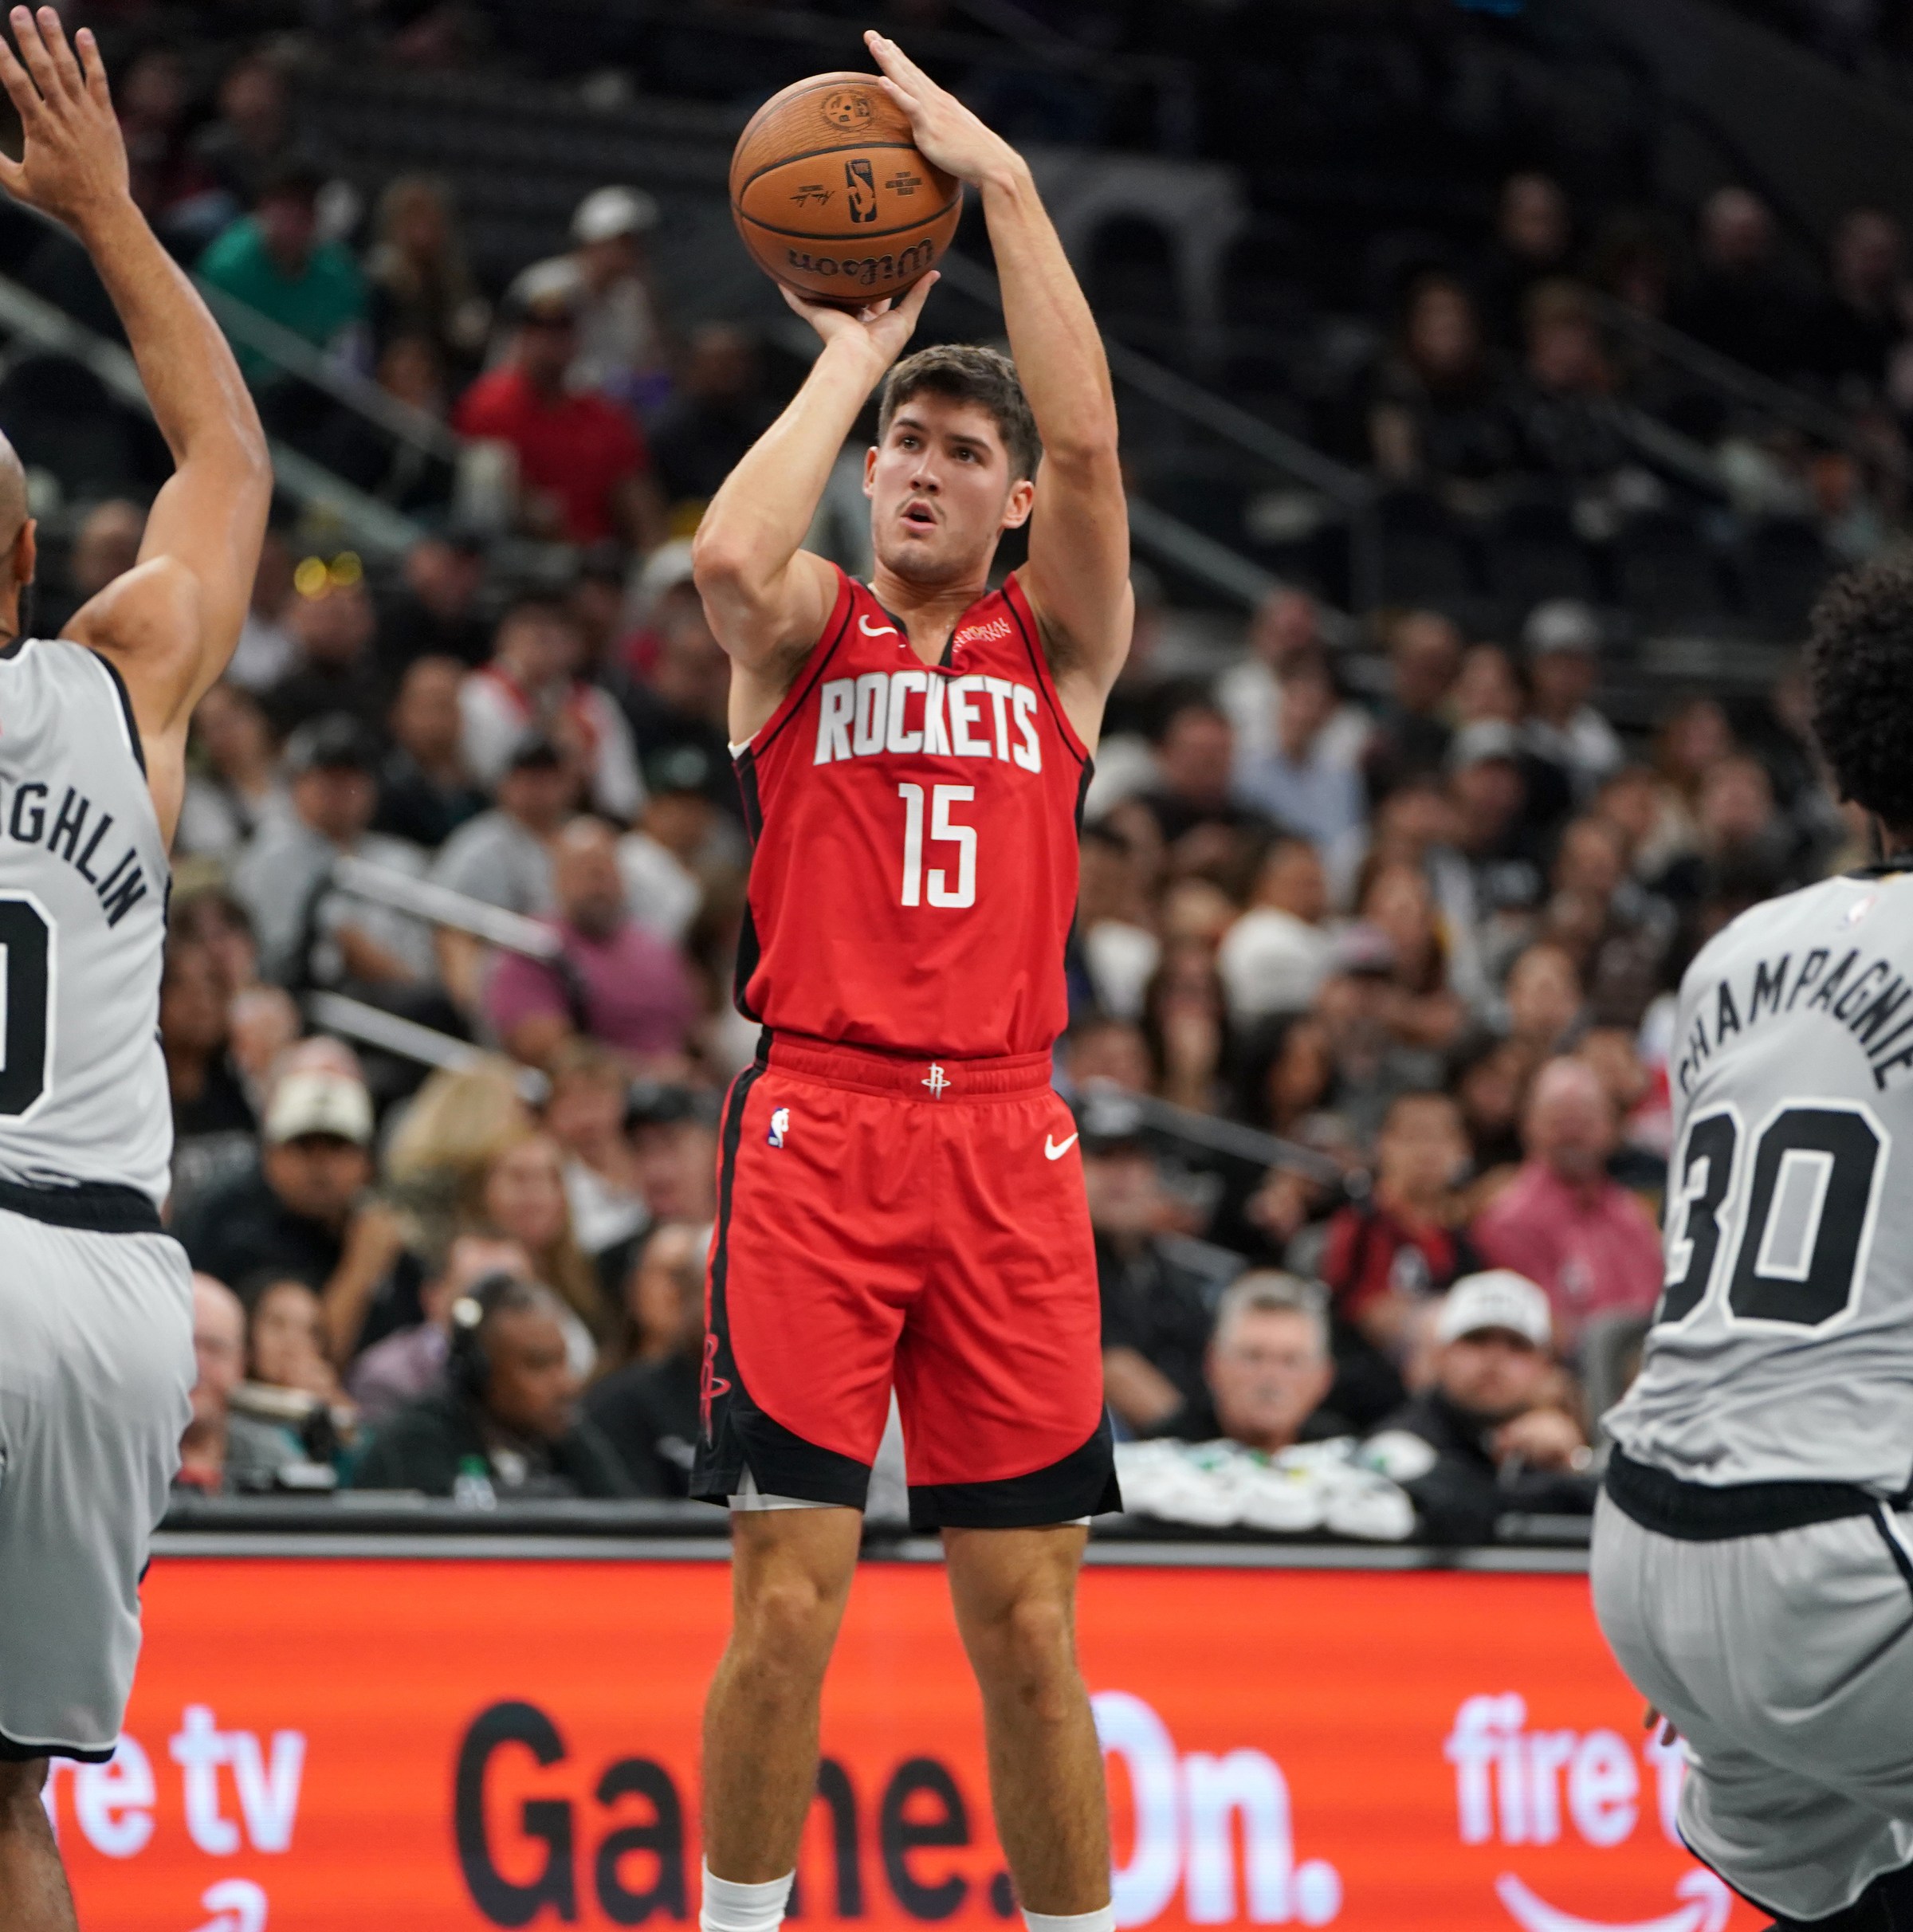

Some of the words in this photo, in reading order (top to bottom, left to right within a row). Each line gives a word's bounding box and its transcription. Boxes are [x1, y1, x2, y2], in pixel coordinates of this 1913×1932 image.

[787, 238, 935, 285] Wilson
[813, 670, 1042, 774] ROCKETS
[0, 781, 147, 929] GHLIN
[898, 783, 978, 909] 15
[1679, 947, 1913, 1091] CHAMPAGNIE
[1653, 1098, 1892, 1341] 30
[168, 1702, 307, 1856] tv
[1444, 1690, 1640, 1848] fire
